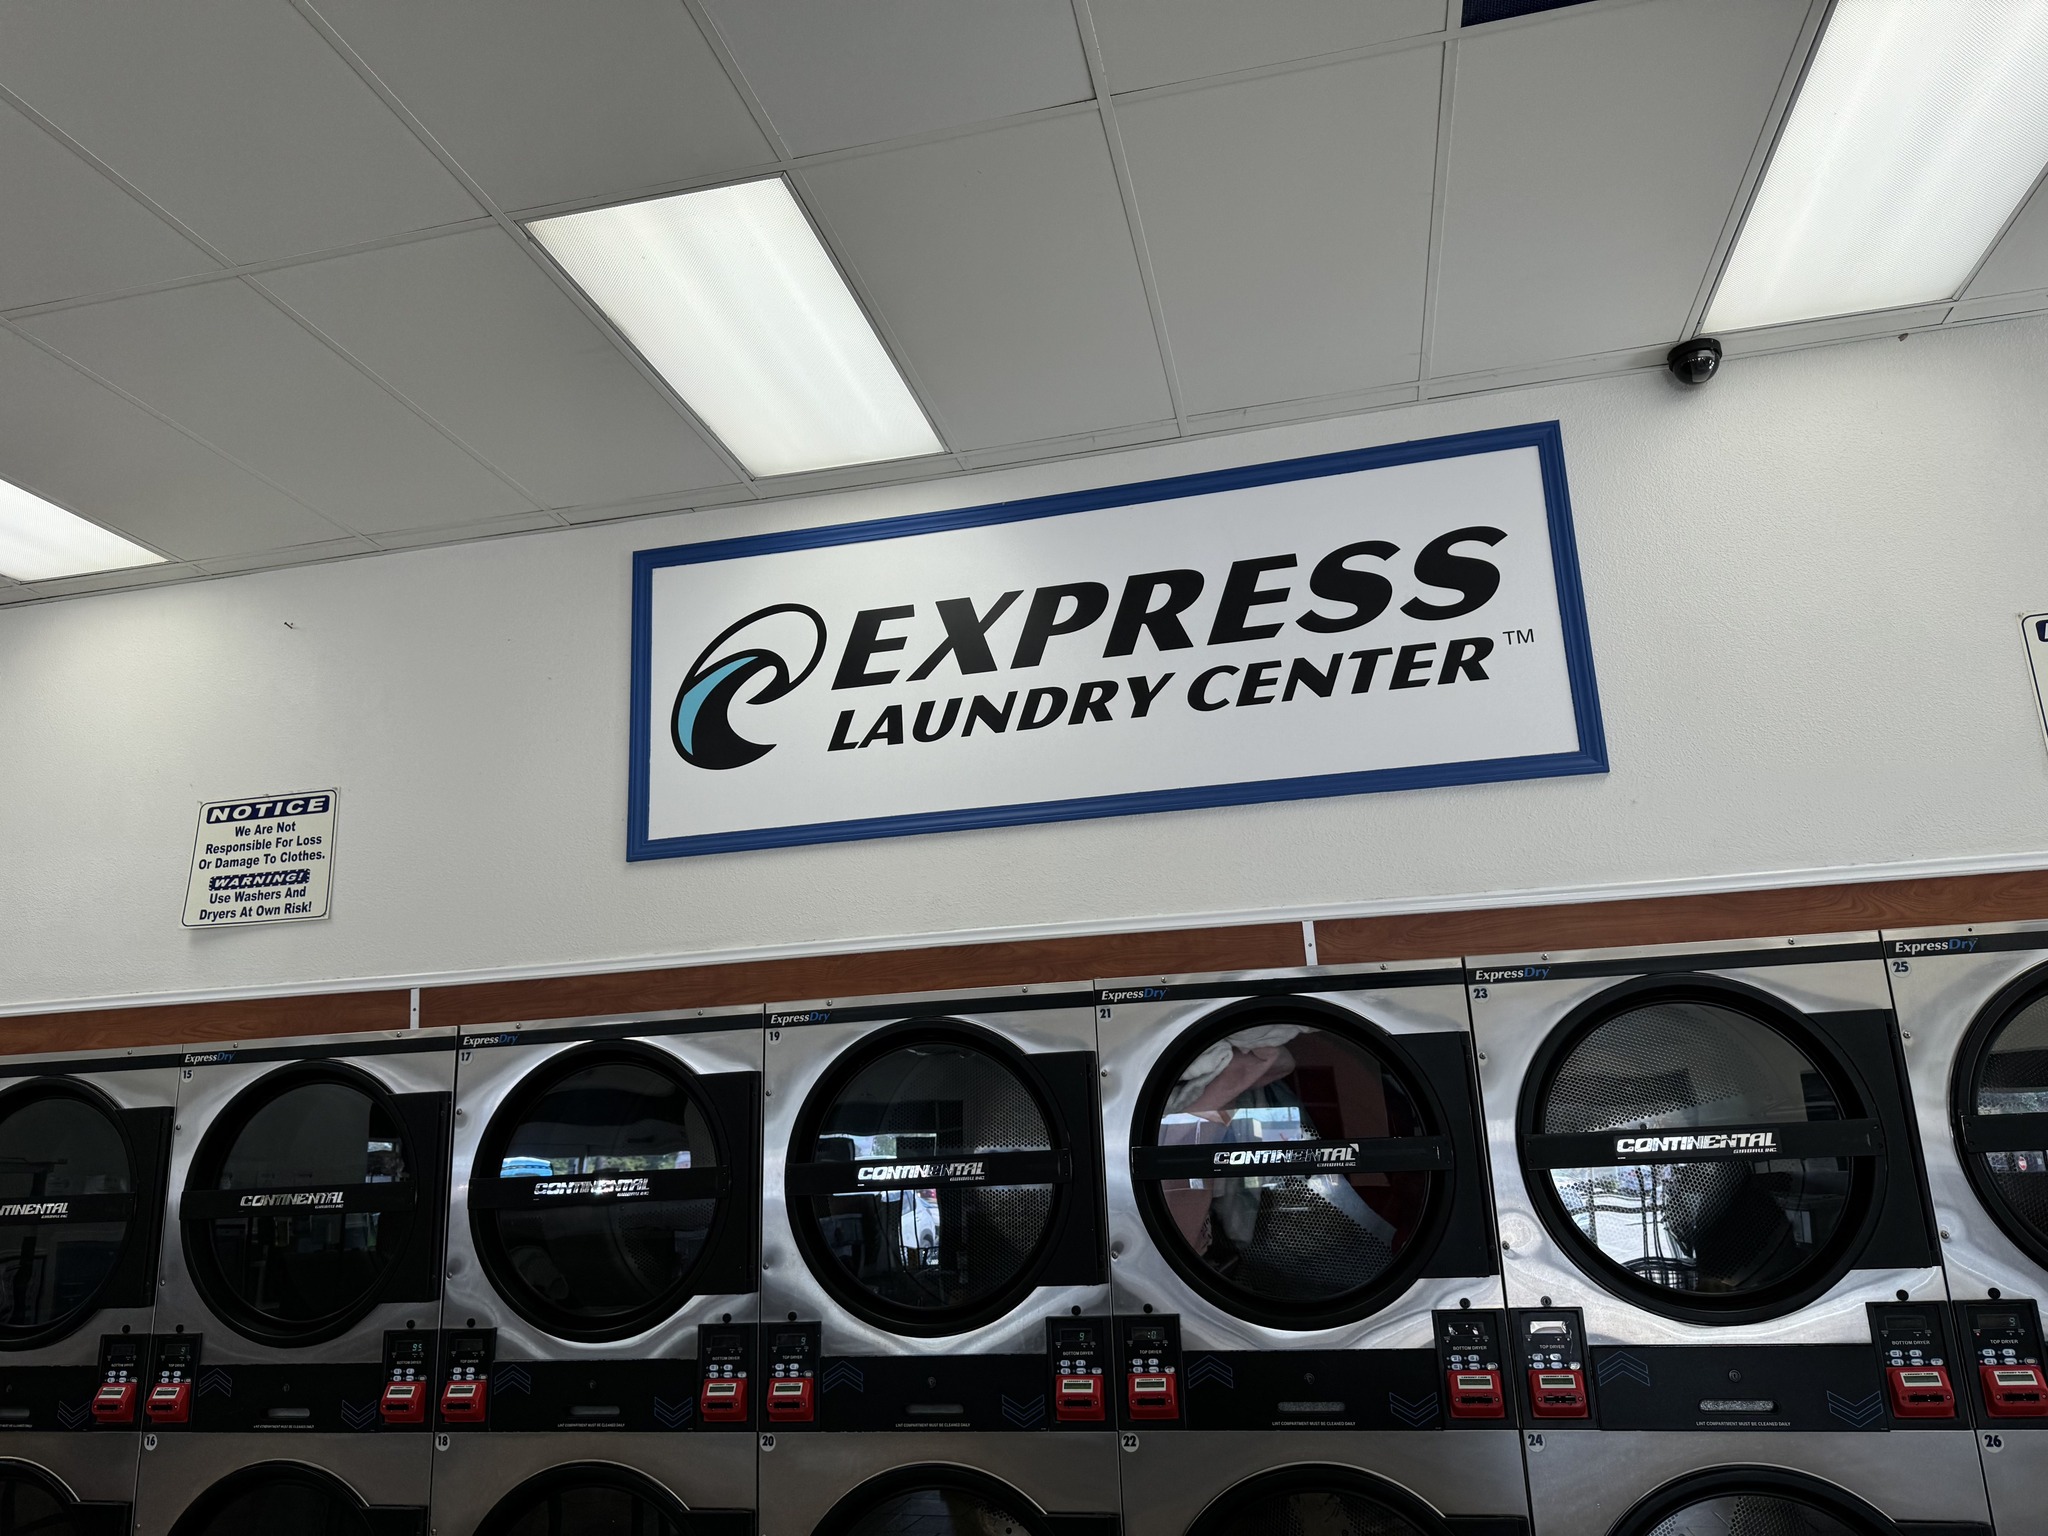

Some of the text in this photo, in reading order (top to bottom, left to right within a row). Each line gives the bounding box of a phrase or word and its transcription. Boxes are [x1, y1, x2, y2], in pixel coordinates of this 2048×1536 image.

[831, 526, 1508, 691] EXPRESS
[826, 672, 1177, 752] LAUNDRY
[1186, 636, 1495, 713] CENTER
[209, 797, 326, 823] NOTICE
[235, 821, 296, 837] We Are Not
[205, 835, 322, 855] Responsible For Loss
[198, 849, 325, 870] Or Damage To Clothes.
[214, 872, 304, 888] WARNING!
[209, 886, 307, 904] Use Washers And
[199, 901, 312, 922] Dryers At Own Risk!
[1895, 938, 1977, 955] ExpressDry
[1475, 967, 1550, 982] ExpressDry
[1893, 962, 1909, 972] 25
[1101, 987, 1166, 1002] ExpressDry
[1474, 988, 1487, 998] 23
[770, 1011, 831, 1026] ExpressDry
[1100, 1009, 1111, 1018] 21
[463, 1034, 518, 1047] ExpressDry
[770, 1032, 780, 1041] 19
[184, 1052, 234, 1065] ExpressDry
[461, 1052, 471, 1061] 17
[183, 1070, 192, 1079] 15
[1617, 1132, 1776, 1153] CONTINENTAL
[1213, 1147, 1357, 1165] CONTINENTAL
[858, 1162, 985, 1180] CONTINENTAL
[534, 1178, 649, 1195] CONTINENTAL
[240, 1192, 344, 1206] CONTINENTAL
[146, 1436, 156, 1447] 16
[437, 1435, 448, 1446] 18
[762, 1435, 774, 1447] 20
[1123, 1435, 1137, 1447] 22
[1528, 1434, 1544, 1446] 24
[1984, 1434, 2002, 1447] 26
